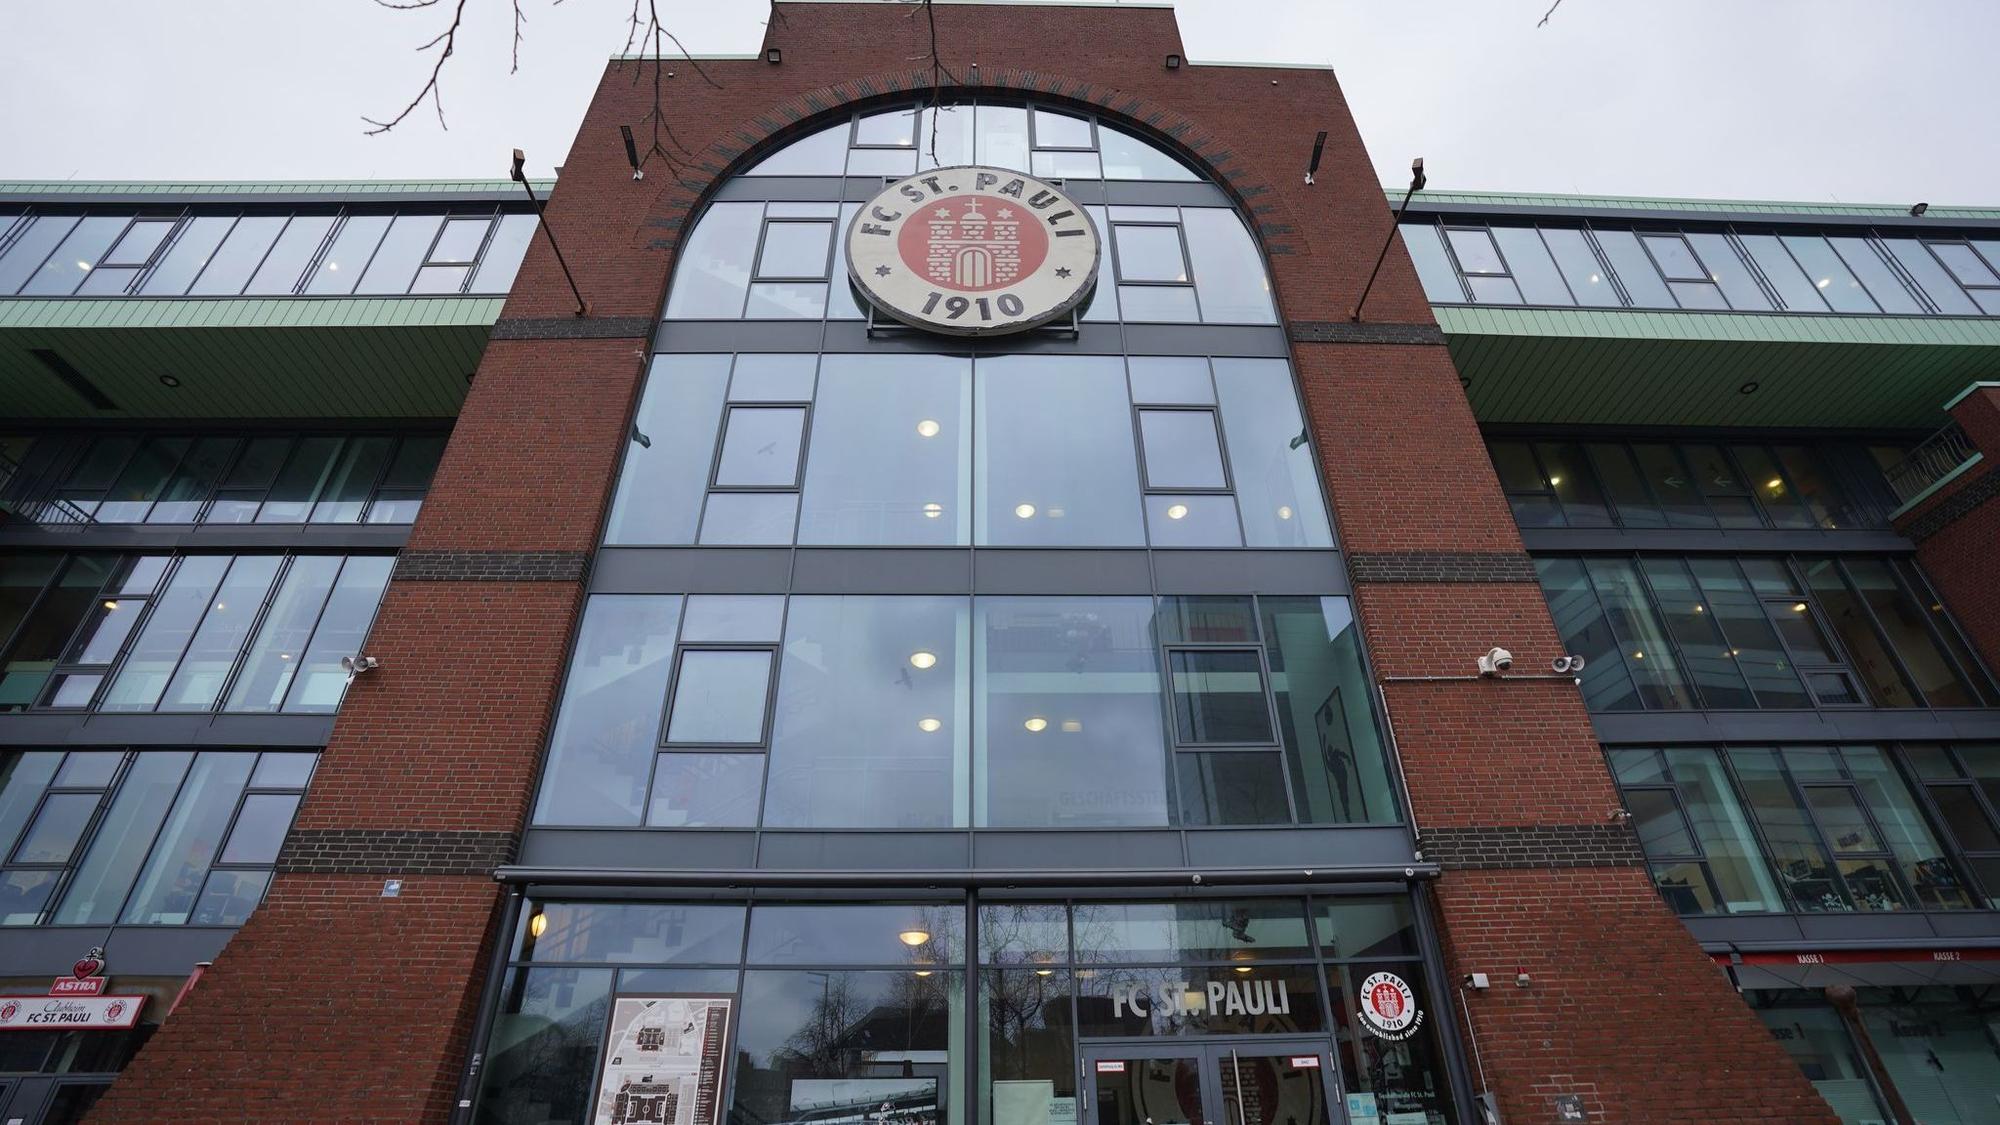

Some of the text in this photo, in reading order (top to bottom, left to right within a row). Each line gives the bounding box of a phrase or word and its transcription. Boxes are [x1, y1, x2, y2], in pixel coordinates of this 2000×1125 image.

[860, 172, 1086, 238] FC ST. PAULI
[920, 291, 1024, 321] 1910
[1797, 954, 1818, 964] KASSE
[1933, 952, 1961, 961] KASSE 2
[55, 981, 97, 991] ASTRA
[1362, 988, 1371, 1000] FC
[1383, 974, 1412, 999] PAULI
[1114, 980, 1290, 1018] FC ST. PAULI
[27, 1013, 91, 1023] FC ST. PAULI
[1381, 1019, 1404, 1029] 1910
[1415, 1009, 1424, 1026] 1910
